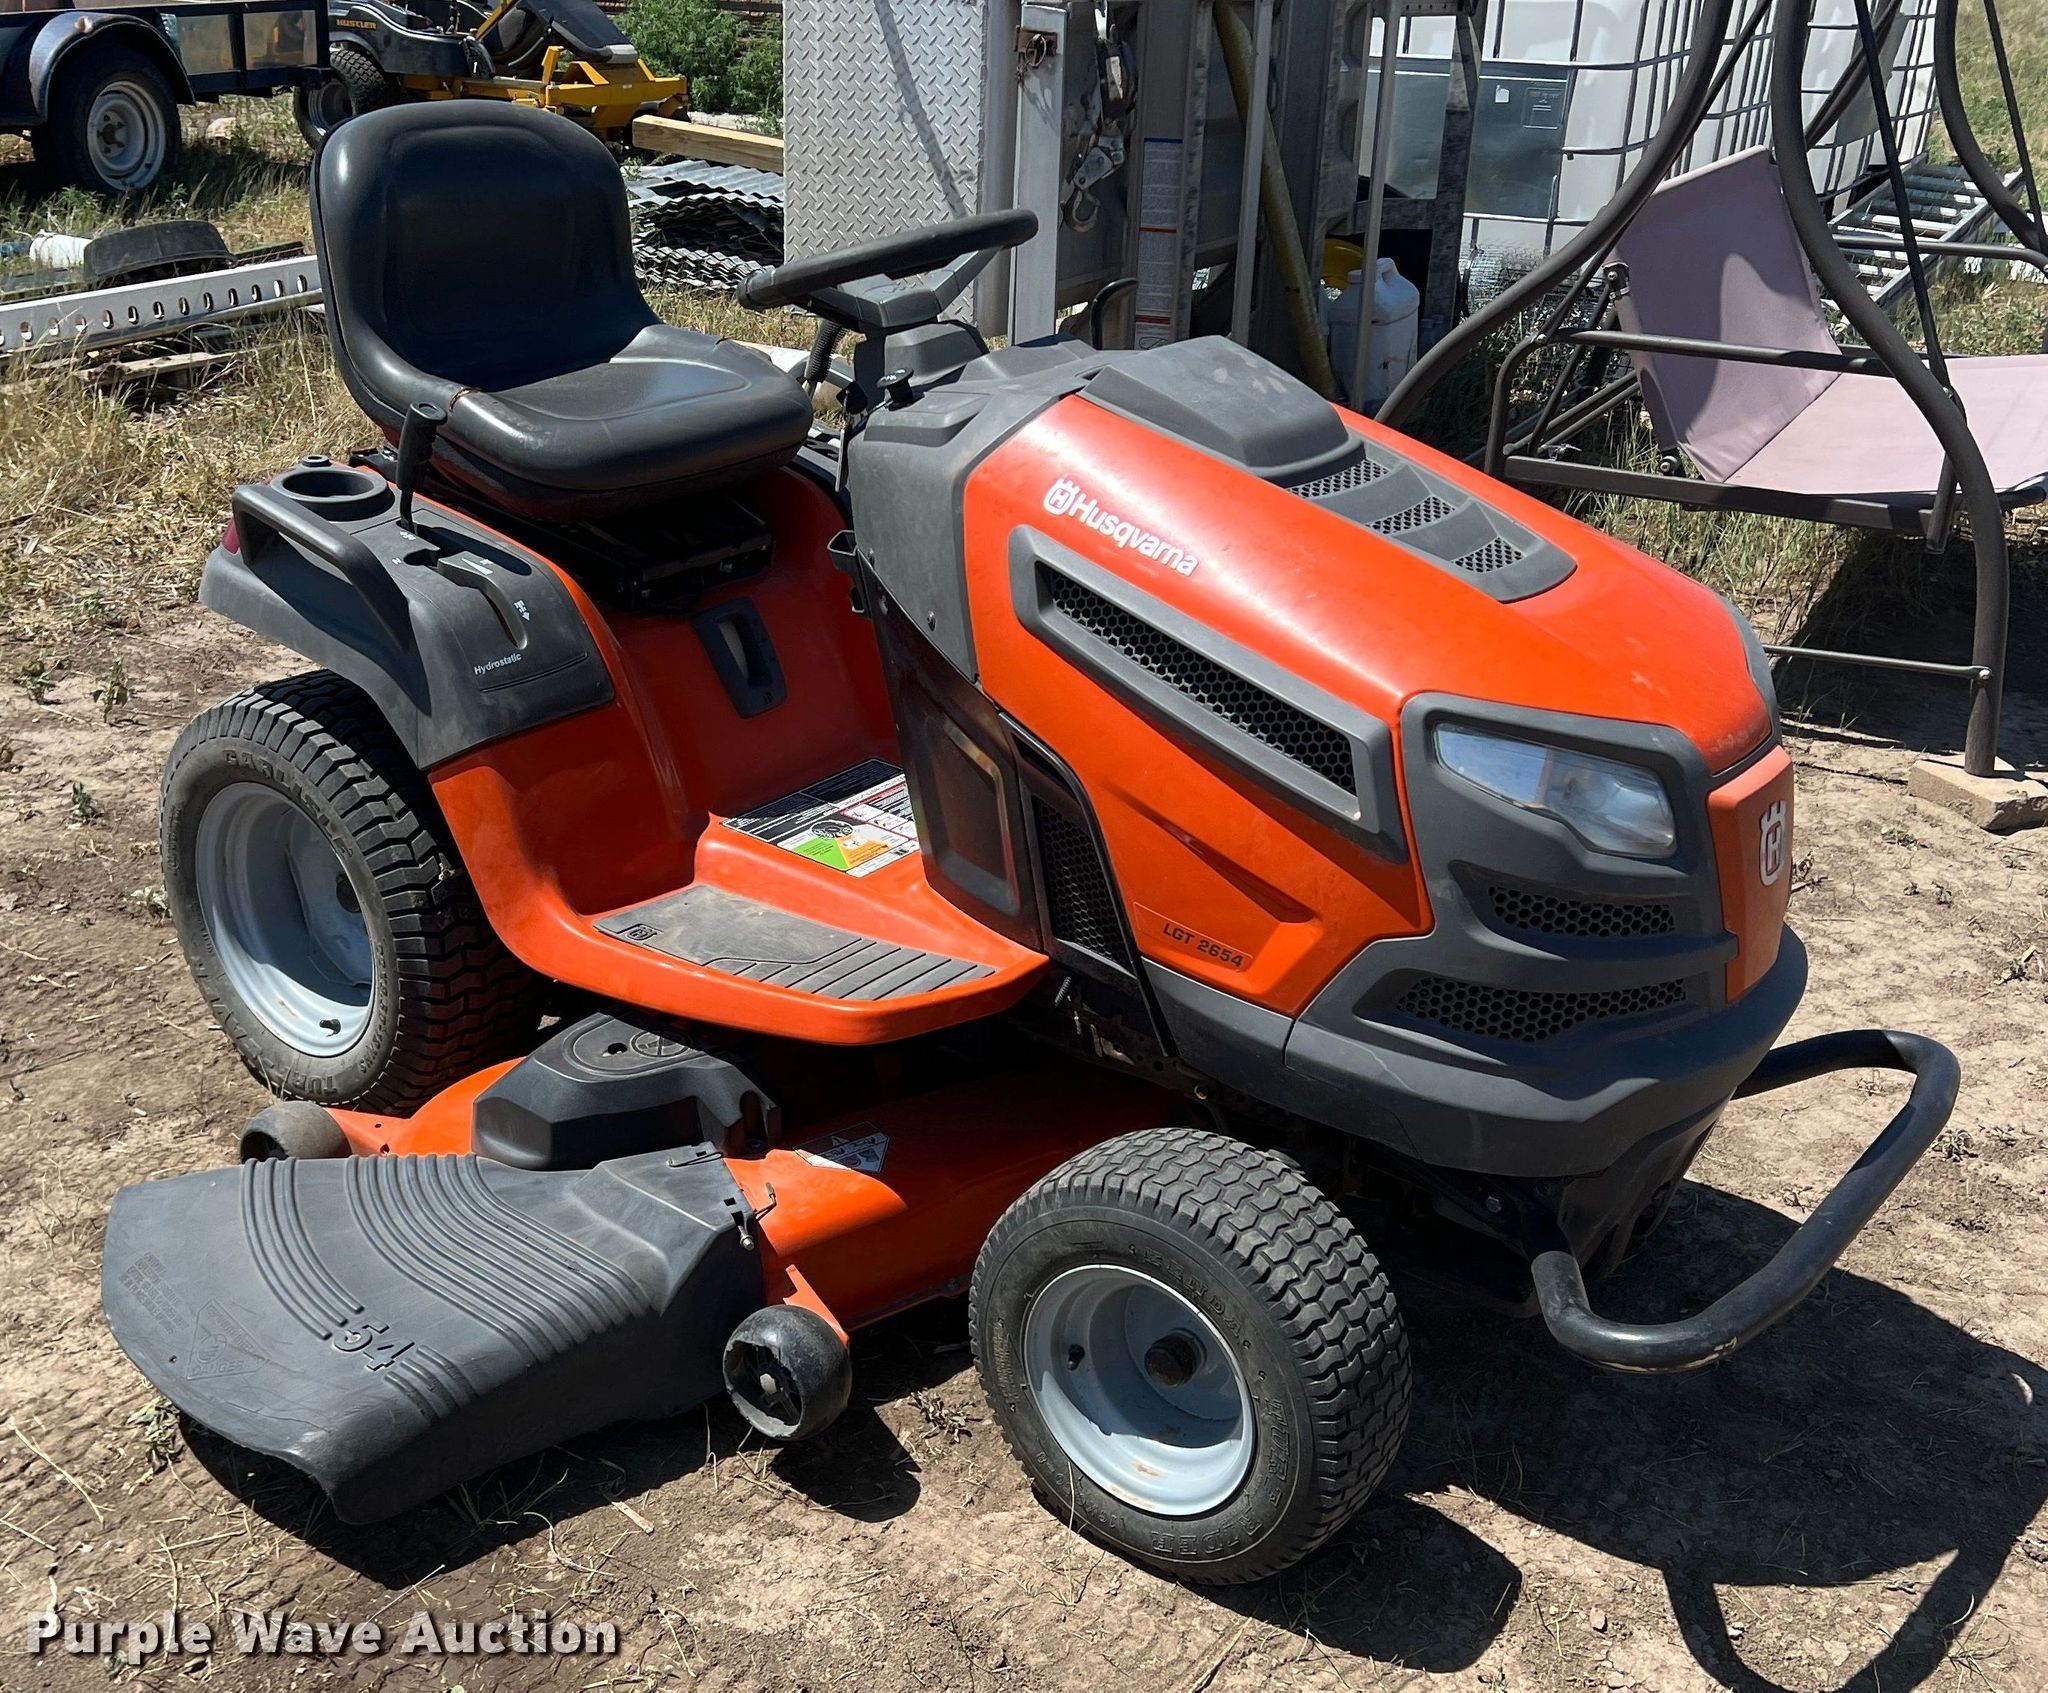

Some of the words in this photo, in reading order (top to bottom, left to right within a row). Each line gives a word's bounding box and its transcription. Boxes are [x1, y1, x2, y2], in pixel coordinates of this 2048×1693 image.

[1069, 493, 1199, 577] Husqvarna
[473, 653, 522, 675] Hydrostatic
[1163, 922, 1195, 945] LGT
[1197, 940, 1245, 967] 2654
[332, 1321, 416, 1372] 54
